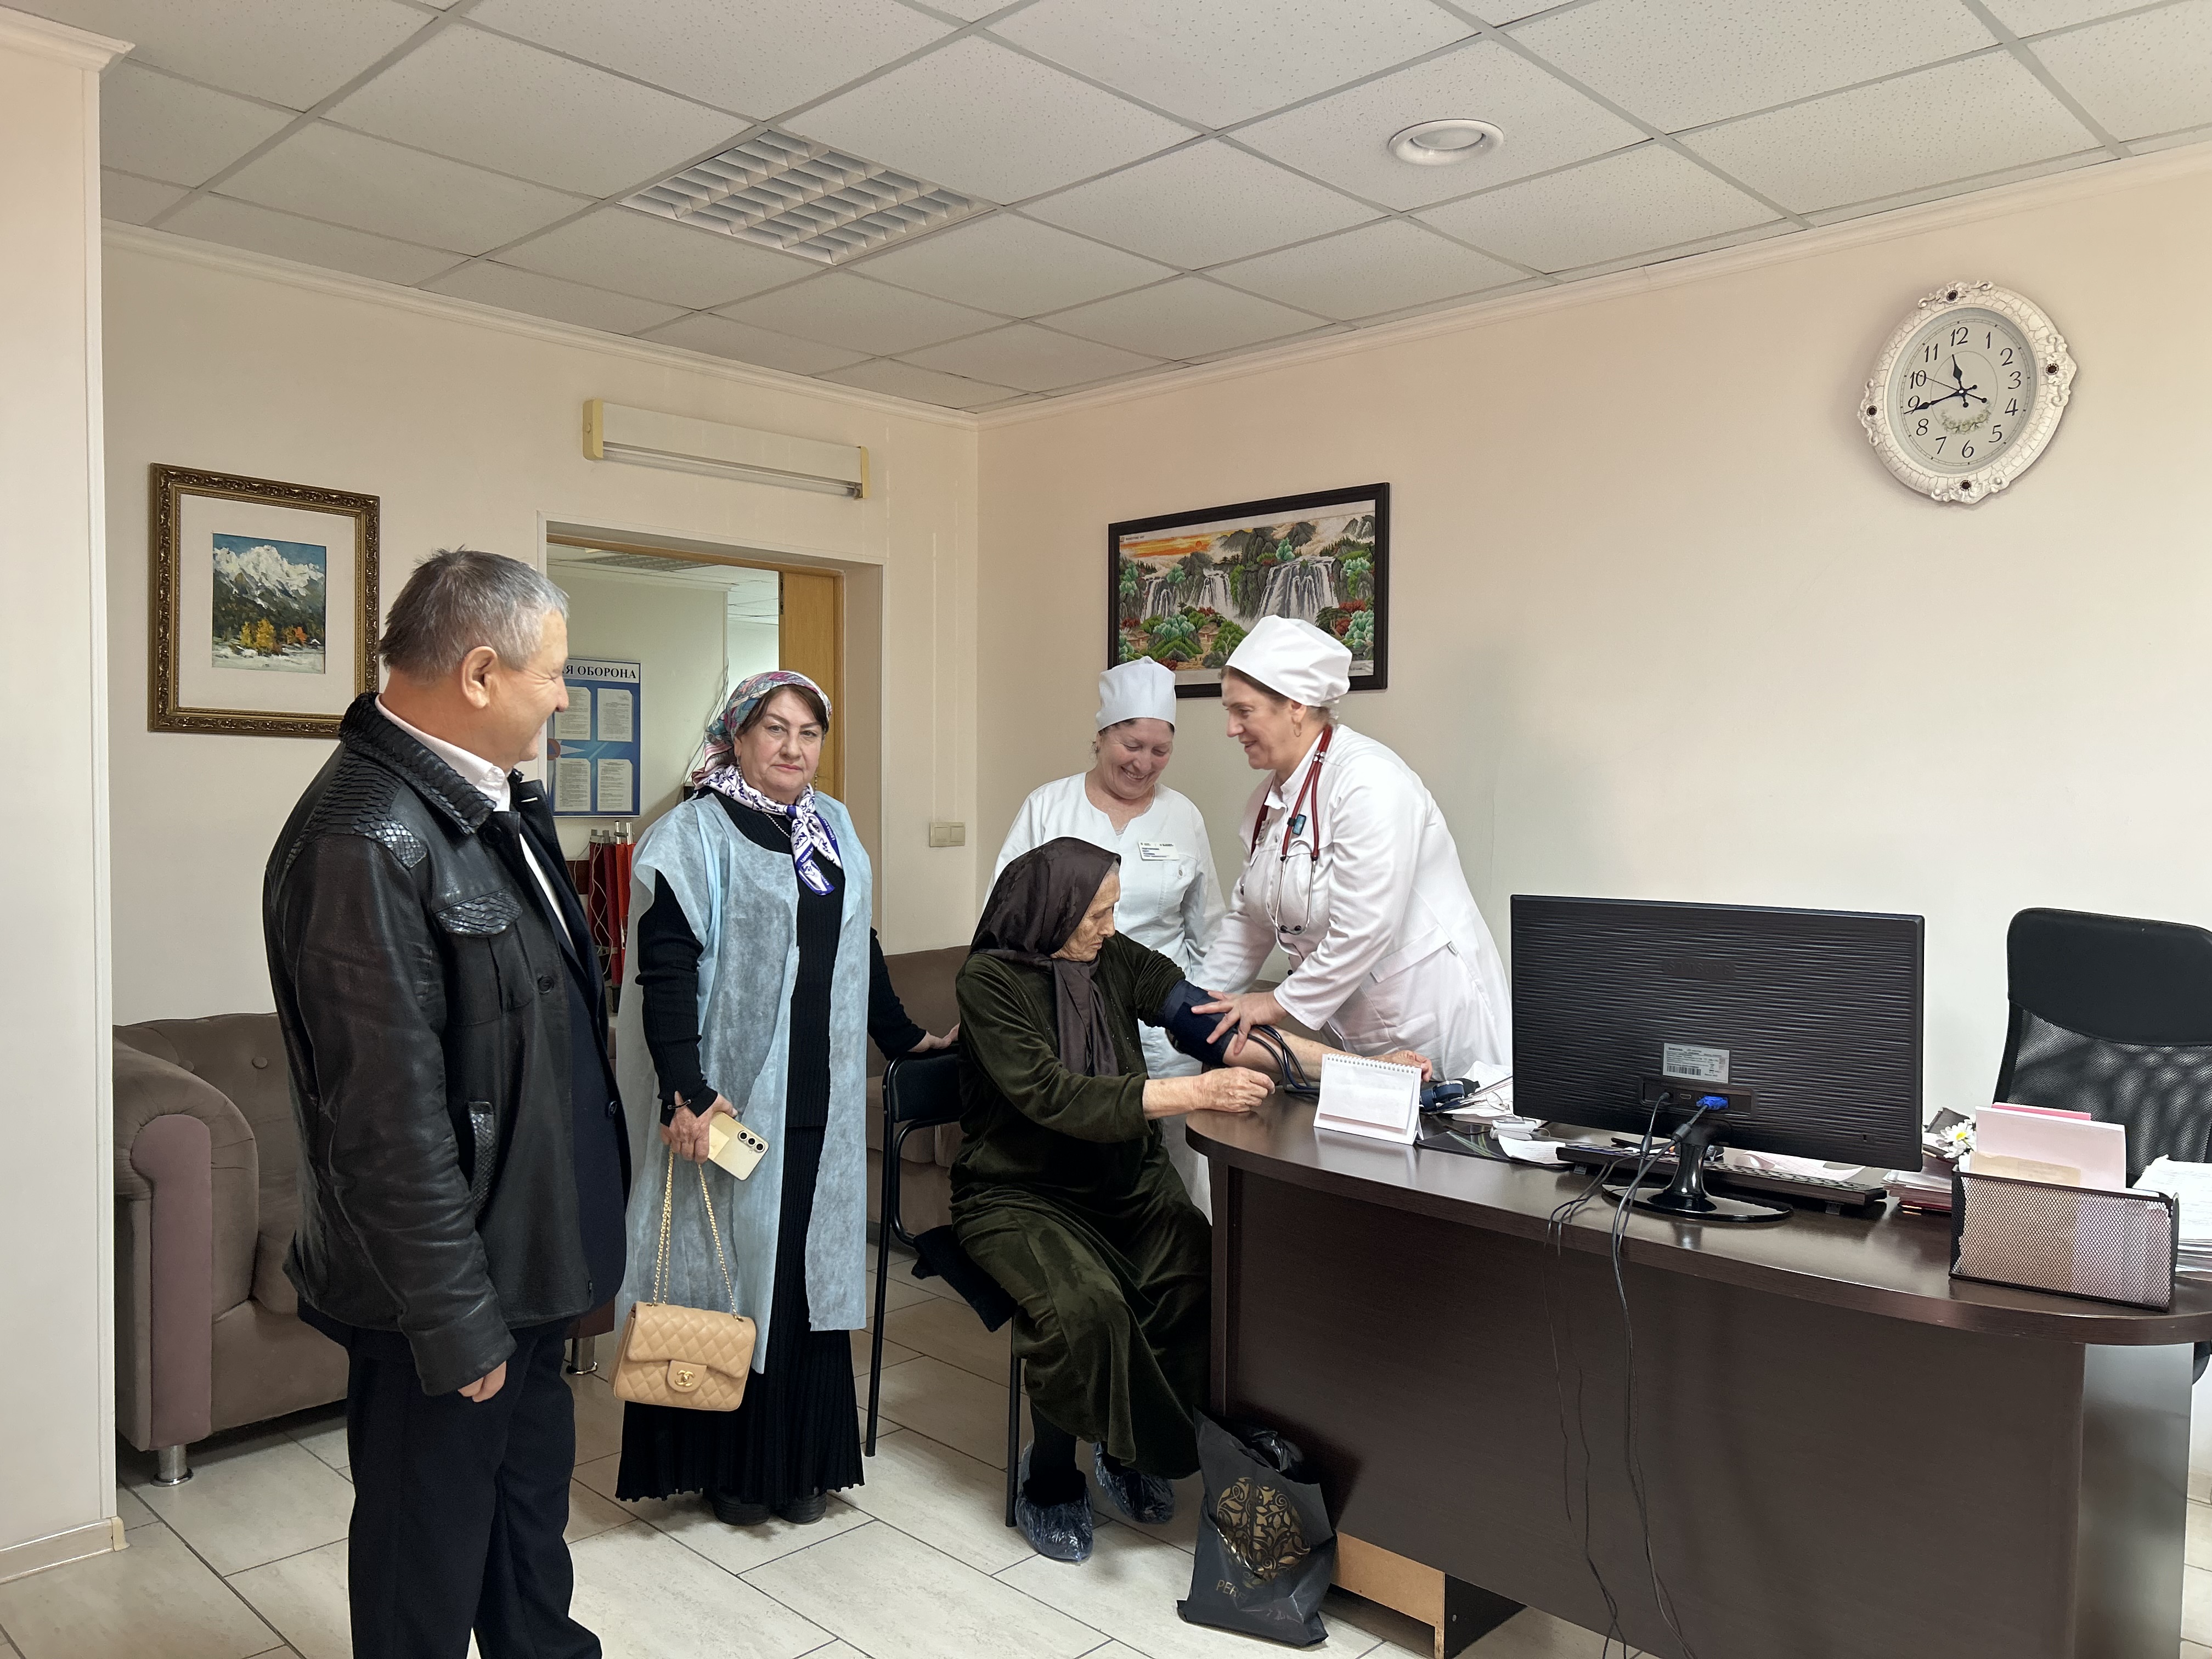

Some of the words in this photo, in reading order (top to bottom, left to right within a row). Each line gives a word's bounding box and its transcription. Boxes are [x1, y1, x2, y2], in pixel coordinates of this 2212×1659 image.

[1950, 327, 1969, 347] 12
[1985, 331, 1991, 349] 1
[1924, 343, 1939, 363] 11
[2000, 348, 2013, 366] 2
[1910, 370, 1927, 389] 10
[2007, 371, 2022, 390] 3
[1908, 396, 1921, 415] 9
[2005, 398, 2019, 416] 4
[1916, 418, 1929, 436] 8
[1988, 424, 2002, 443] 5
[1935, 436, 1947, 454] 7
[1961, 440, 1974, 458] 6
[562, 665, 574, 674] Я
[577, 665, 636, 679] ОБОРОНА
